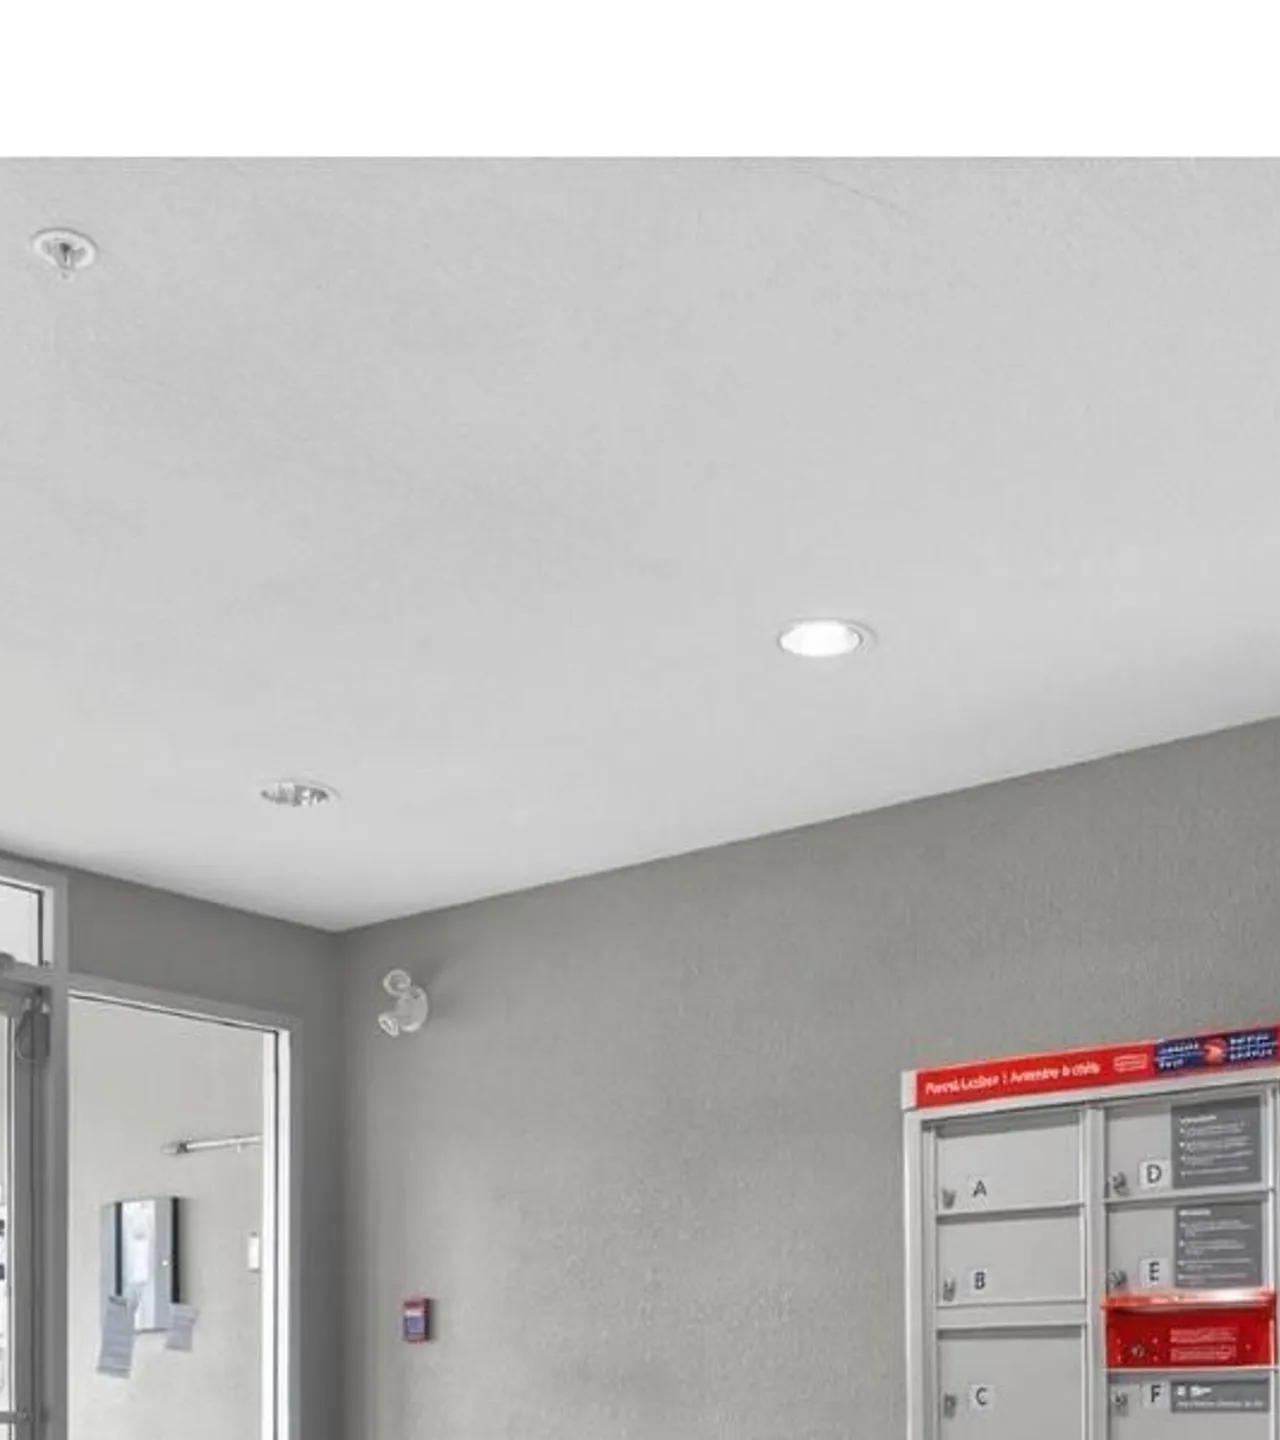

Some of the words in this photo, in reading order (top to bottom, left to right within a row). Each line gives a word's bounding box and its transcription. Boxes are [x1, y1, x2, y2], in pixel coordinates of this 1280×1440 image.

[1146, 1164, 1162, 1184] D
[972, 1180, 988, 1198] A
[974, 1271, 986, 1291] B
[1149, 1261, 1160, 1282] E
[975, 1387, 988, 1406] C
[1150, 1385, 1161, 1404] F
